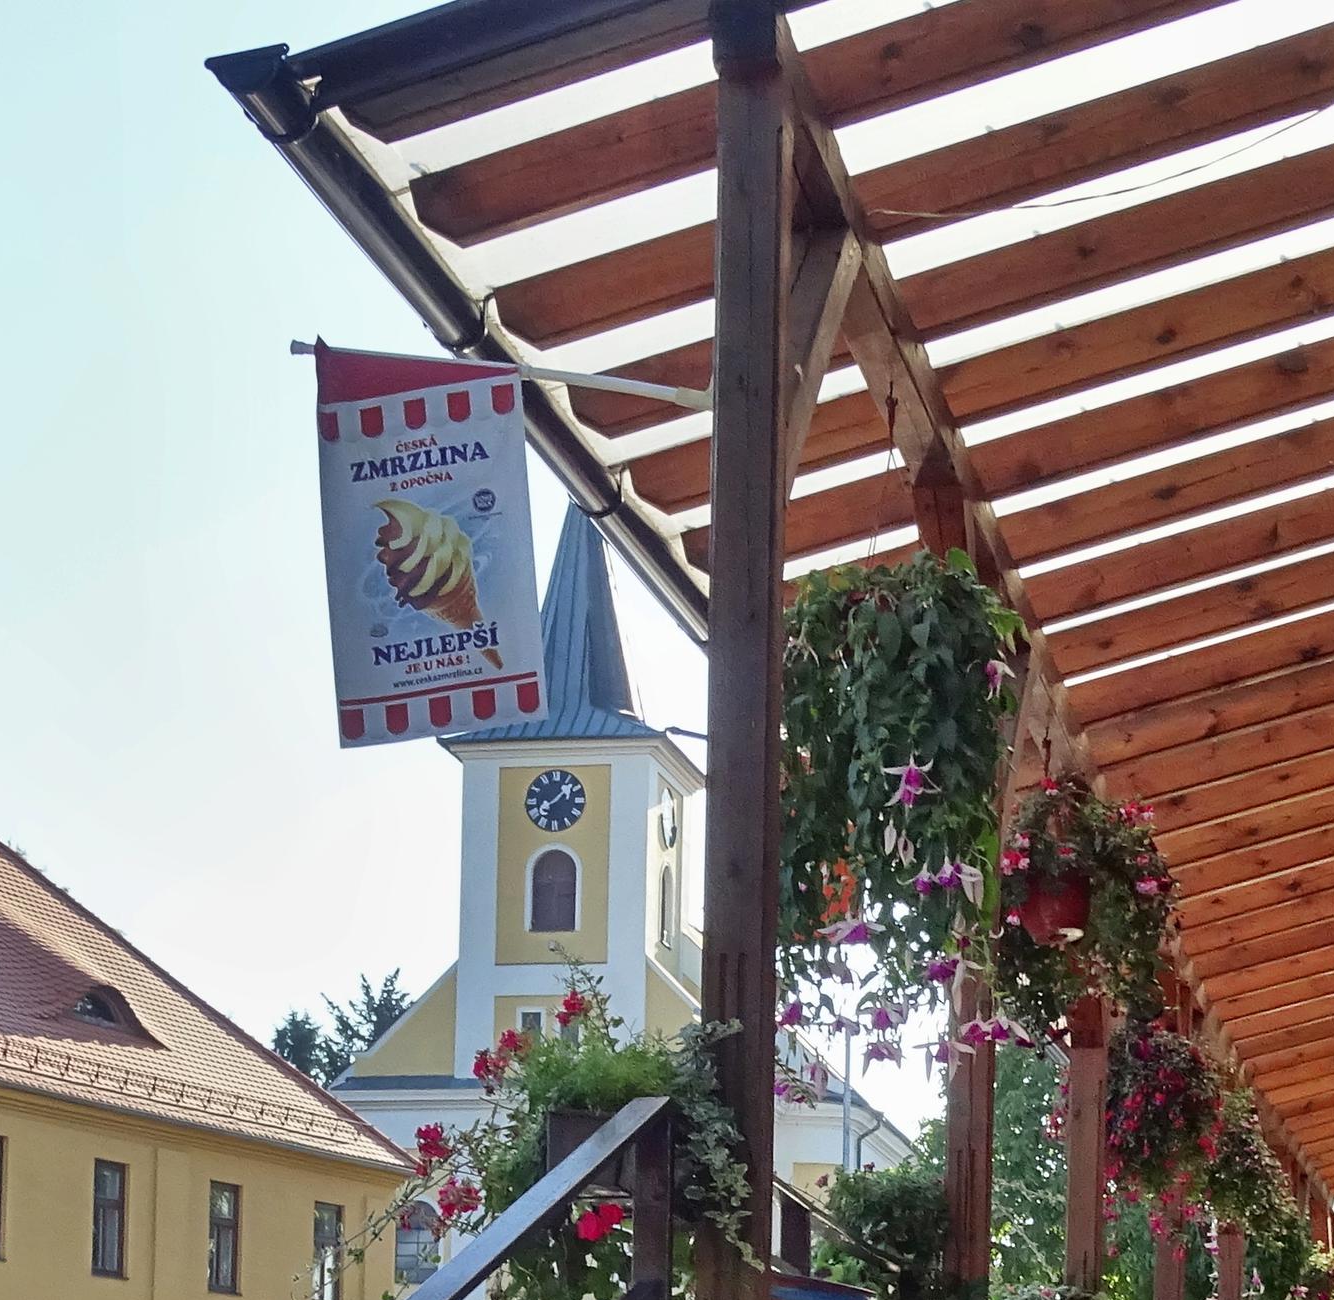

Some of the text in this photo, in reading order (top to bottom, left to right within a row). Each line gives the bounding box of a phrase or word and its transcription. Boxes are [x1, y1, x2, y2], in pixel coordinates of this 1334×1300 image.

[396, 434, 438, 453] ČESKÁ
[350, 441, 490, 483] ZMRZLINA
[400, 471, 453, 490] OPOČNA
[371, 621, 500, 666] NEJLEPŠÍ
[405, 663, 422, 675] JE
[424, 661, 433, 671] U
